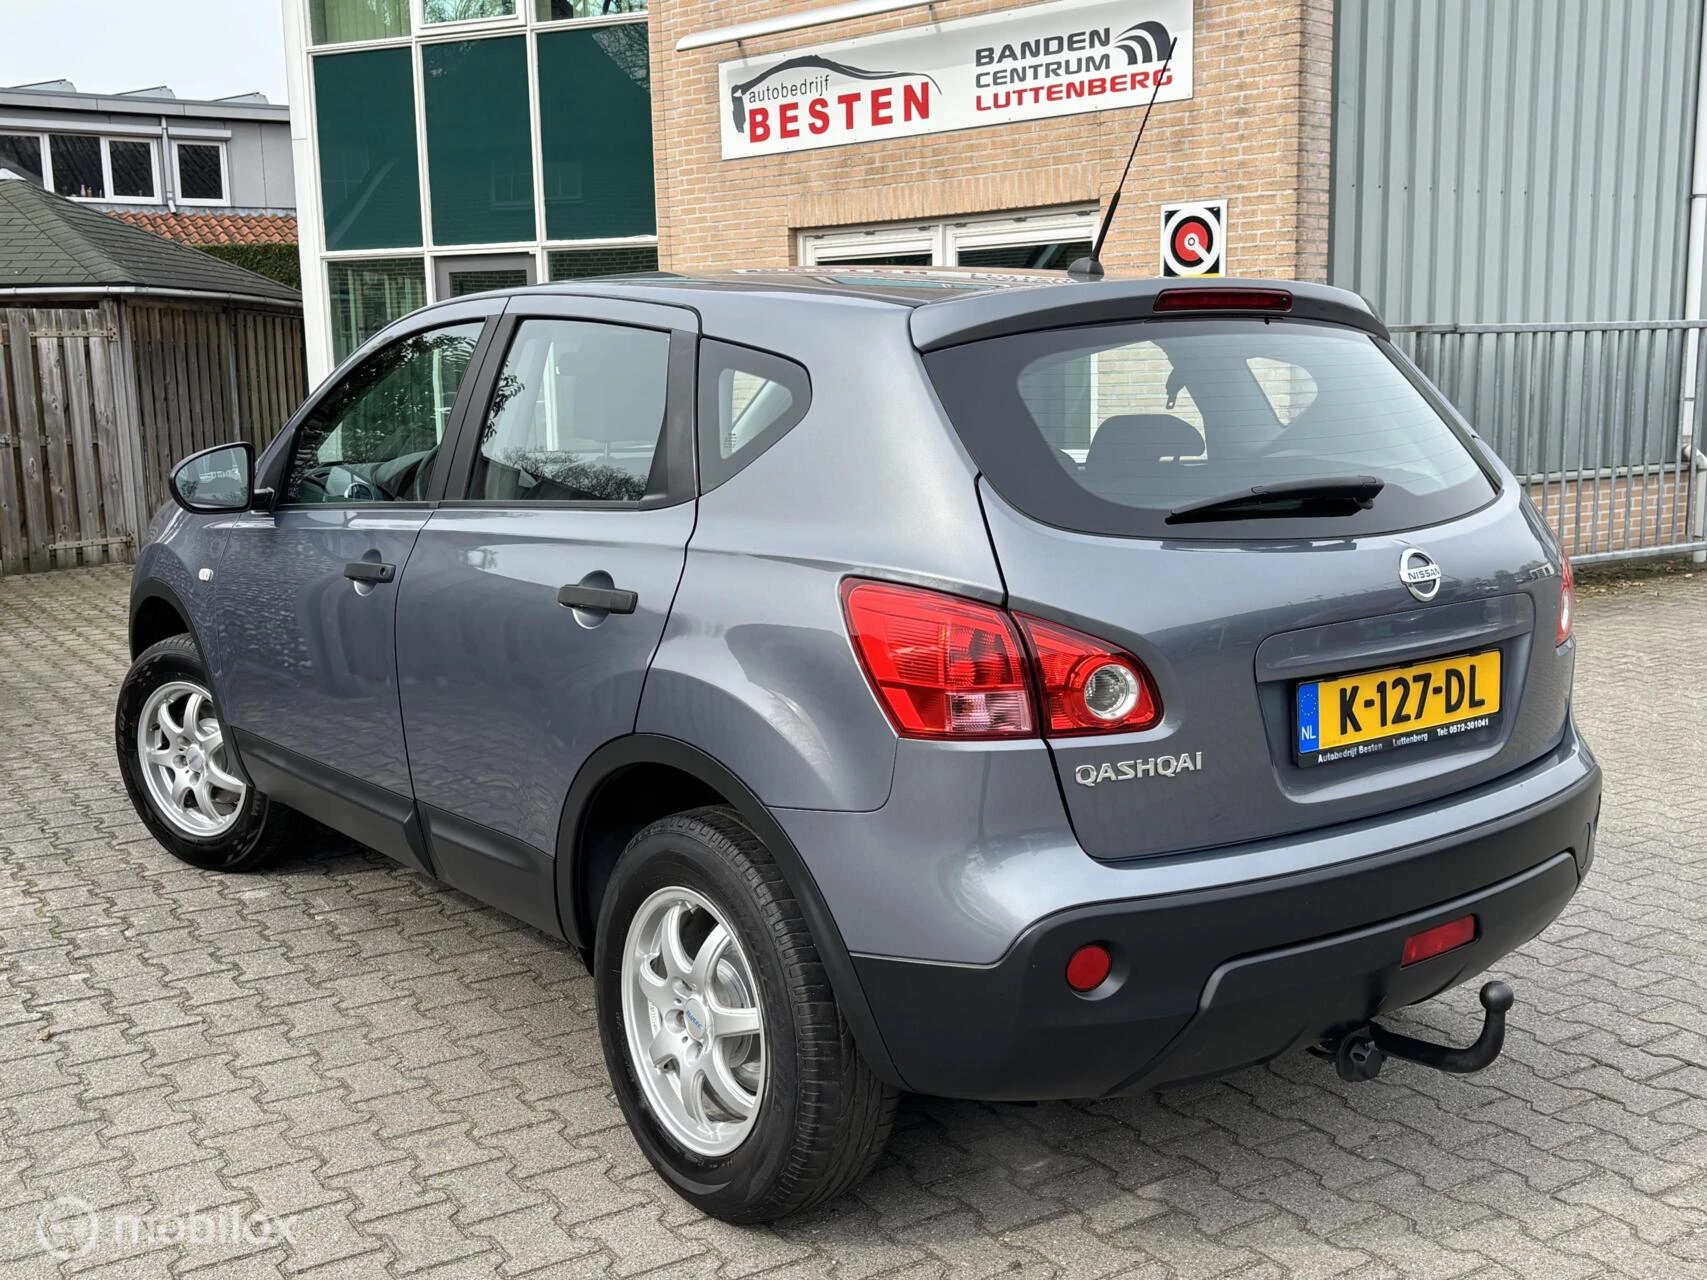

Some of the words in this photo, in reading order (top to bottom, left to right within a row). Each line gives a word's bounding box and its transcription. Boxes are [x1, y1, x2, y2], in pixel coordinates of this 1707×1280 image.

[975, 27, 1111, 67] BANDEN
[748, 74, 831, 104] autobedrijf
[975, 53, 1111, 89] CENTRUM
[975, 68, 1173, 112] LUTTENBERG
[748, 82, 930, 144] BESTEN
[1407, 568, 1440, 580] NISSAN
[1339, 664, 1486, 736] K-127-DL
[1301, 724, 1316, 742] NL
[1317, 746, 1358, 764] Autobedrijf
[1358, 742, 1383, 755] Besten
[1392, 732, 1429, 747] Luttenberg
[1449, 717, 1489, 735] 0572-301041
[1075, 751, 1203, 787] QASHQAI
